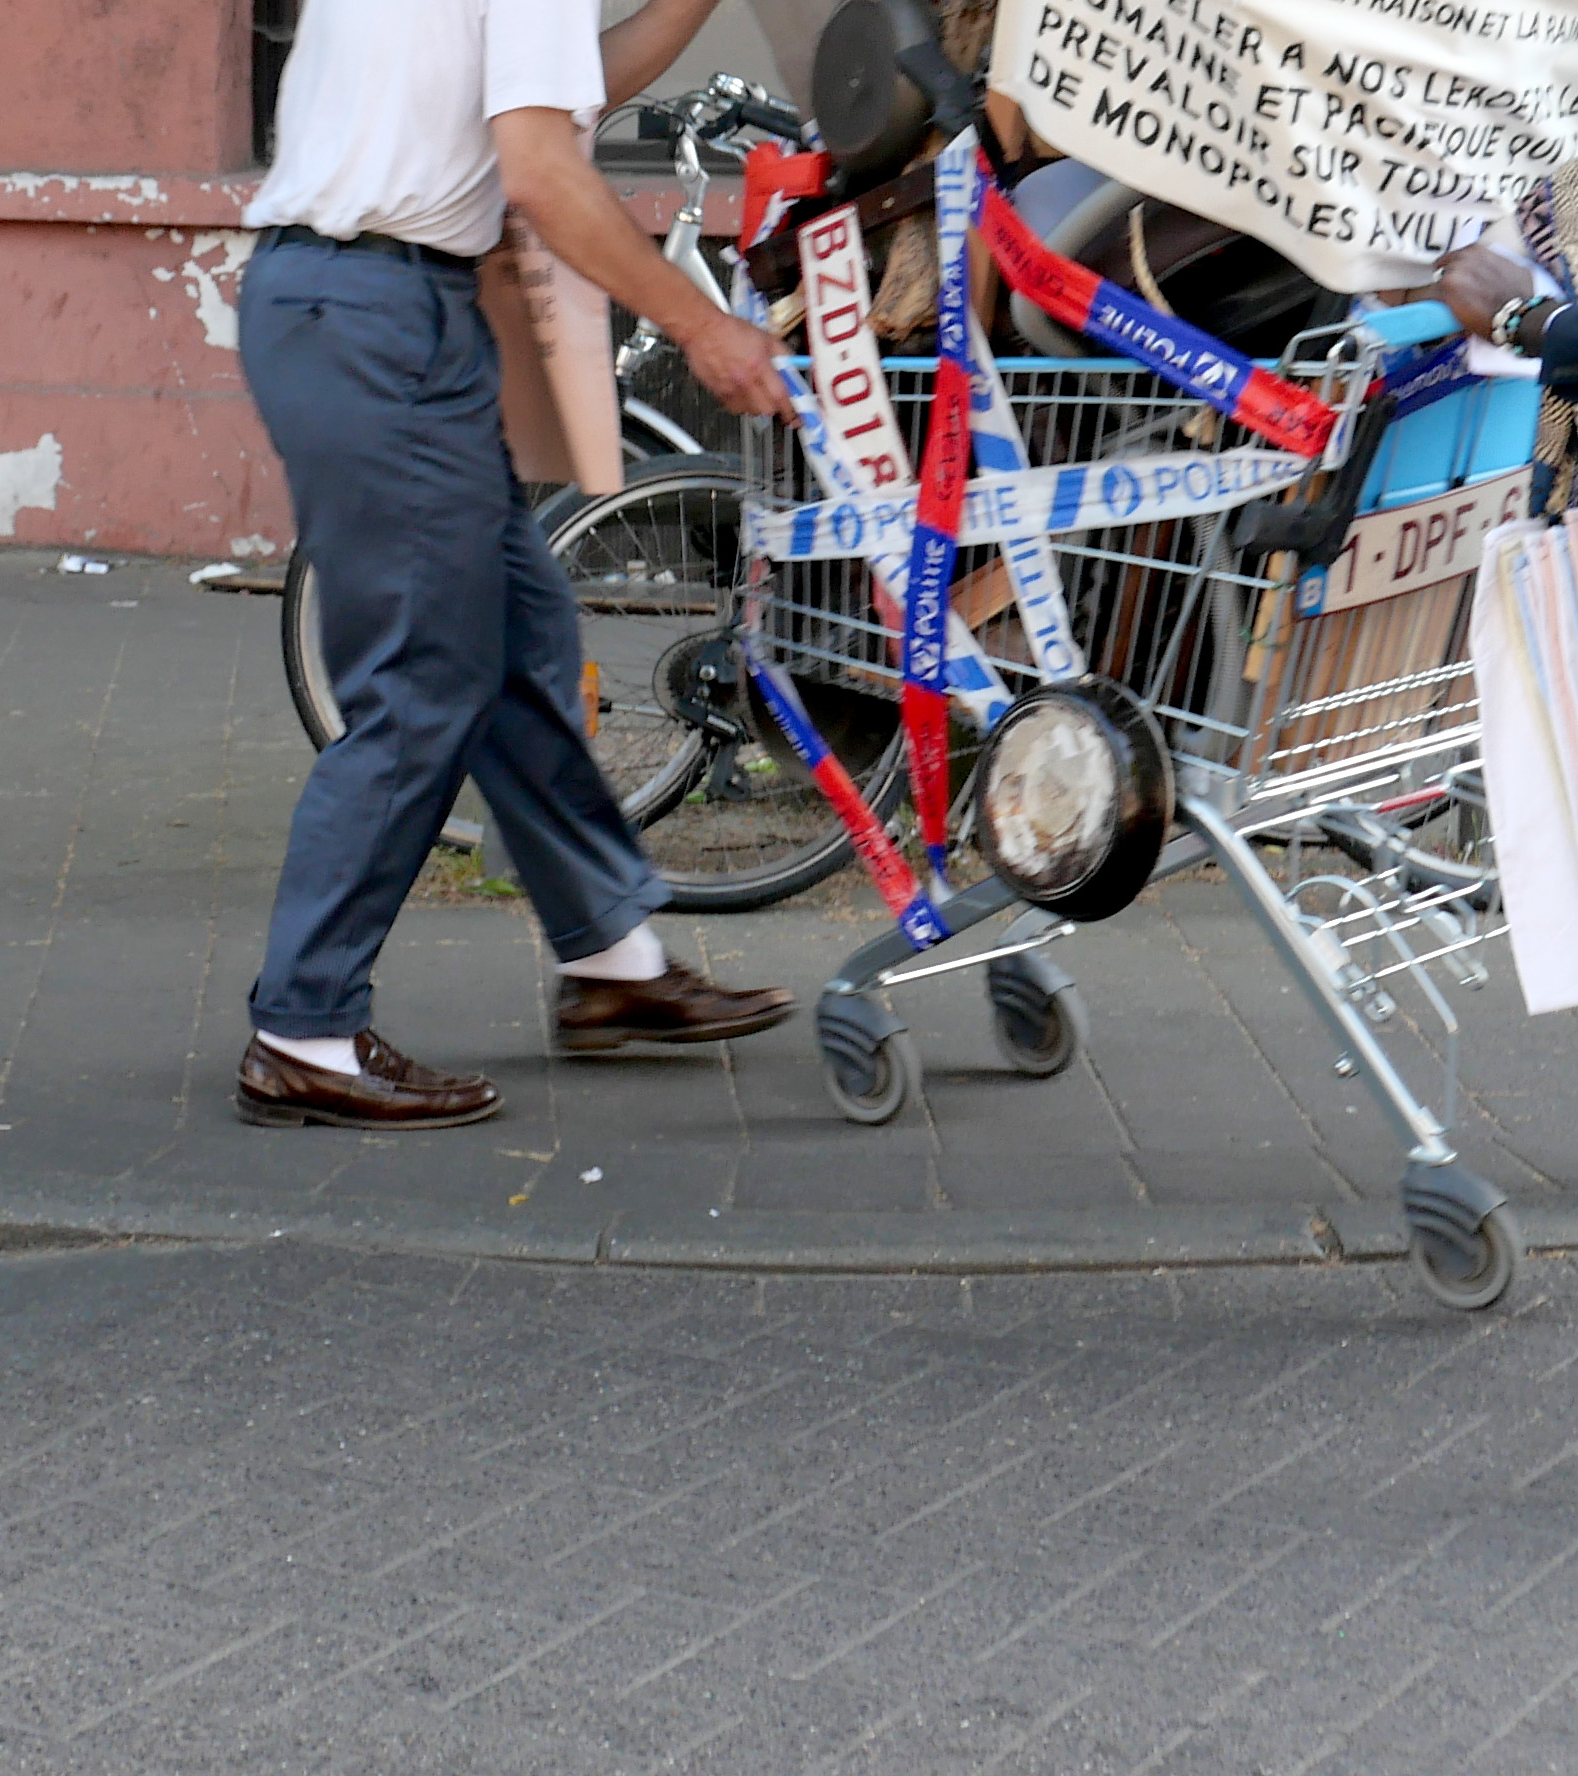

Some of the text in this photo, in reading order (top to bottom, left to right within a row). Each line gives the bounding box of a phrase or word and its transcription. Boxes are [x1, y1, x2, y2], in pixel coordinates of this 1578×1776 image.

[1478, 11, 1511, 41] ET
[1037, 4, 1272, 165] PREVALOIR
[1288, 144, 1361, 186] SUR
[1323, 52, 1412, 100] NOS
[1255, 84, 1311, 123] ET
[1028, 50, 1083, 110] DE
[1091, 86, 1359, 242] MONOPOLES
